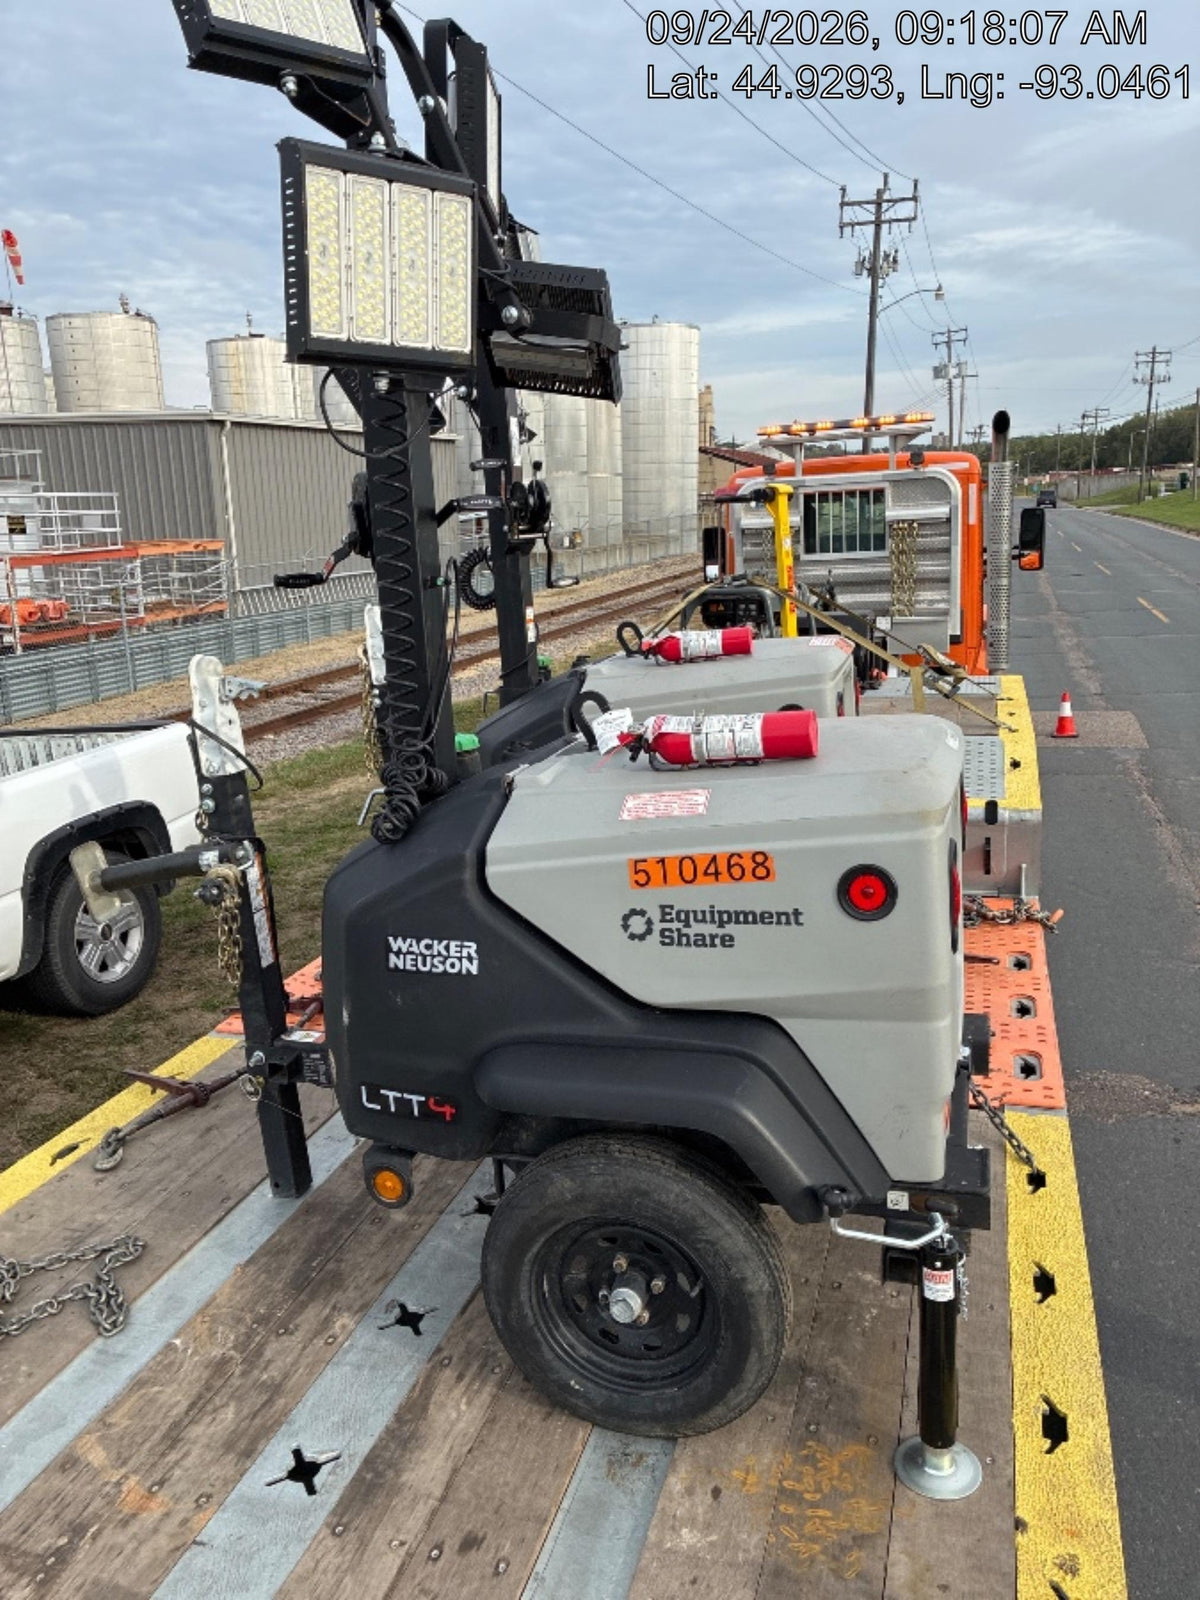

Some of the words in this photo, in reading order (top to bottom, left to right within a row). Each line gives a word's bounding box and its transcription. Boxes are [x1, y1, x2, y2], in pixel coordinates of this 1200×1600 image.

[633, 851, 771, 887] 510468
[658, 904, 804, 928] Equipment
[387, 936, 478, 958] WACKER
[658, 927, 735, 948] Share
[388, 953, 479, 975] NEUSON
[361, 1086, 456, 1121] LTT4
